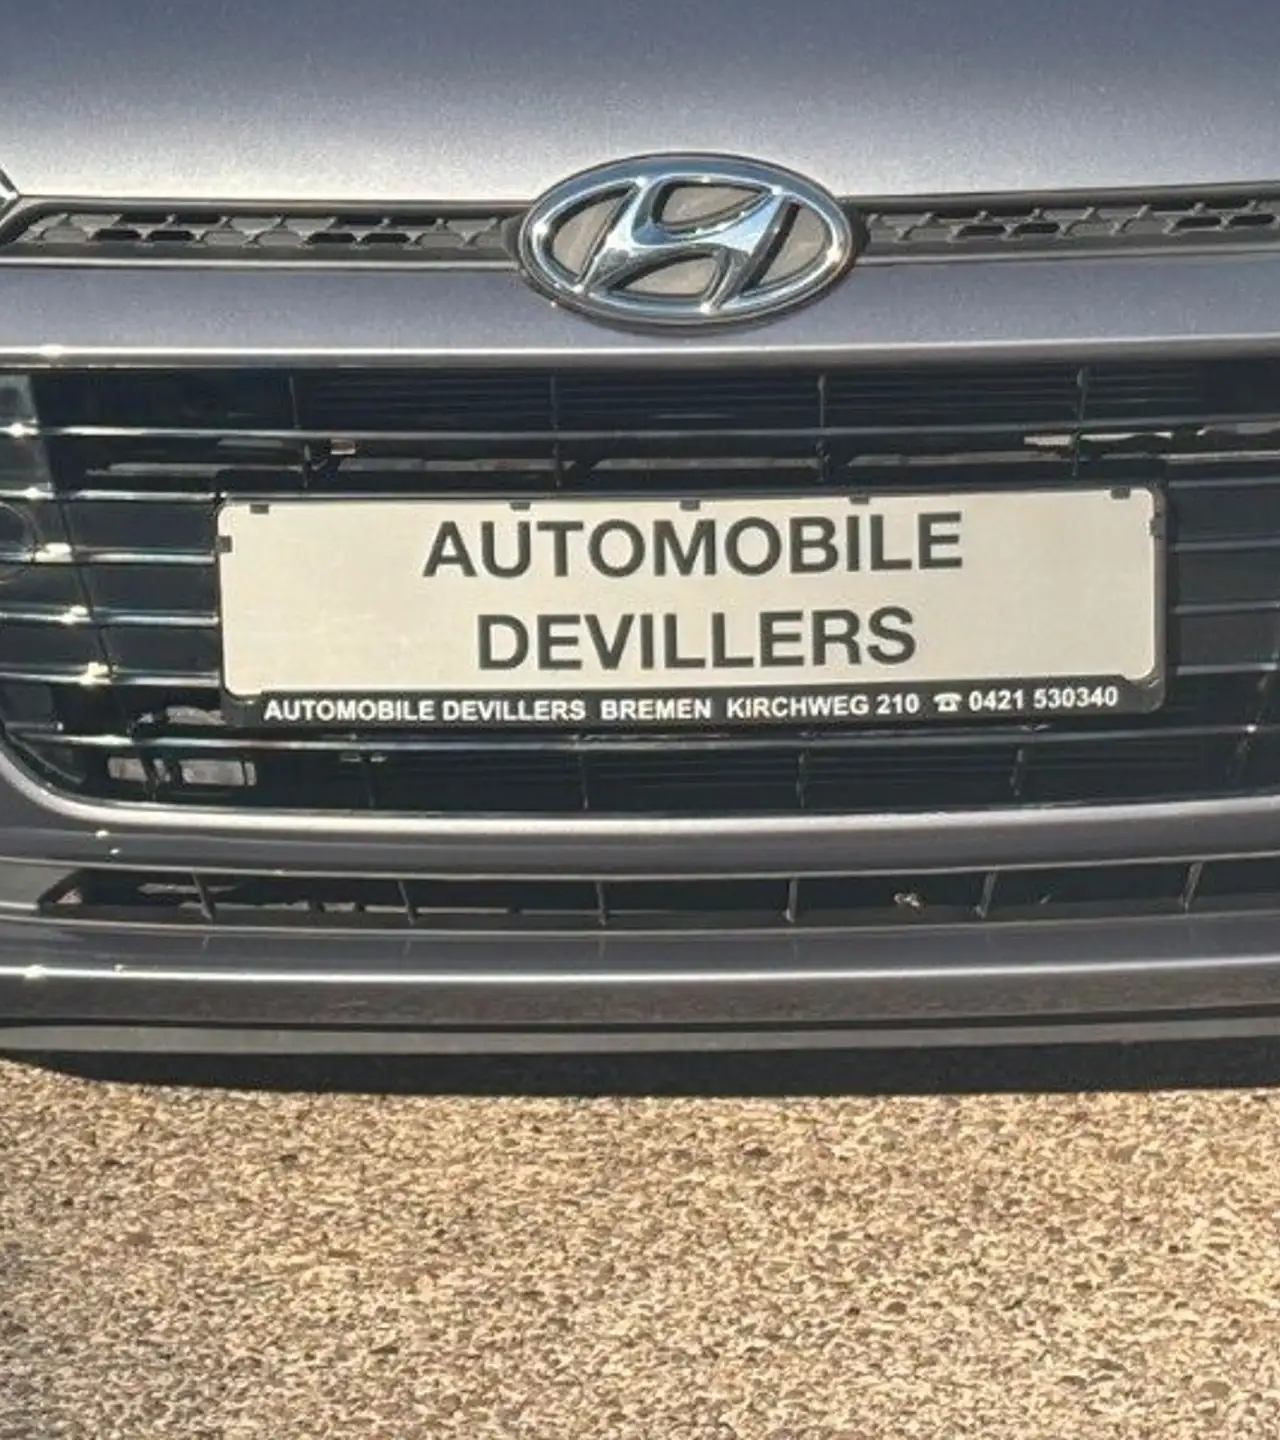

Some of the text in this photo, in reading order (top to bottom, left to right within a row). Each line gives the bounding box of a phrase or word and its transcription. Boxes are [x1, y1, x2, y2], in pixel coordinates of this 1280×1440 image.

[423, 511, 963, 578] AUTOMOBILE
[477, 606, 917, 671] DEVILLERS
[263, 686, 1119, 721] AUTOMOBILE DEVILLERS BREMEN KIRCHWEG 210 0421 530340
